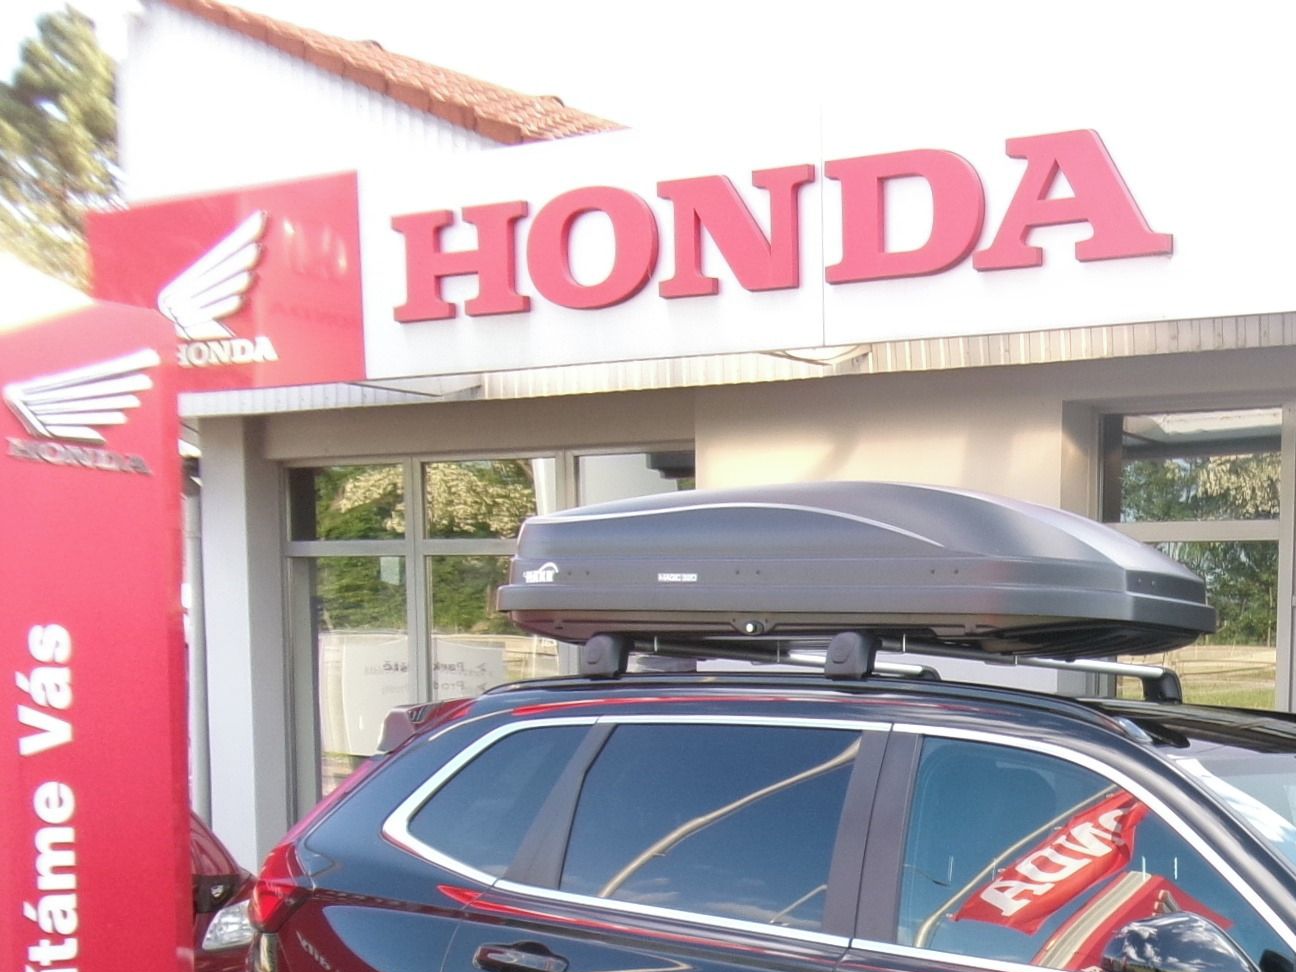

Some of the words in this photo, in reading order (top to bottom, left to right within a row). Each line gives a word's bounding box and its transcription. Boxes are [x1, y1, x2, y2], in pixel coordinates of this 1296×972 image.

[391, 128, 1174, 323] HONDA
[5, 437, 153, 475] HONDA
[15, 623, 74, 757] Vás
